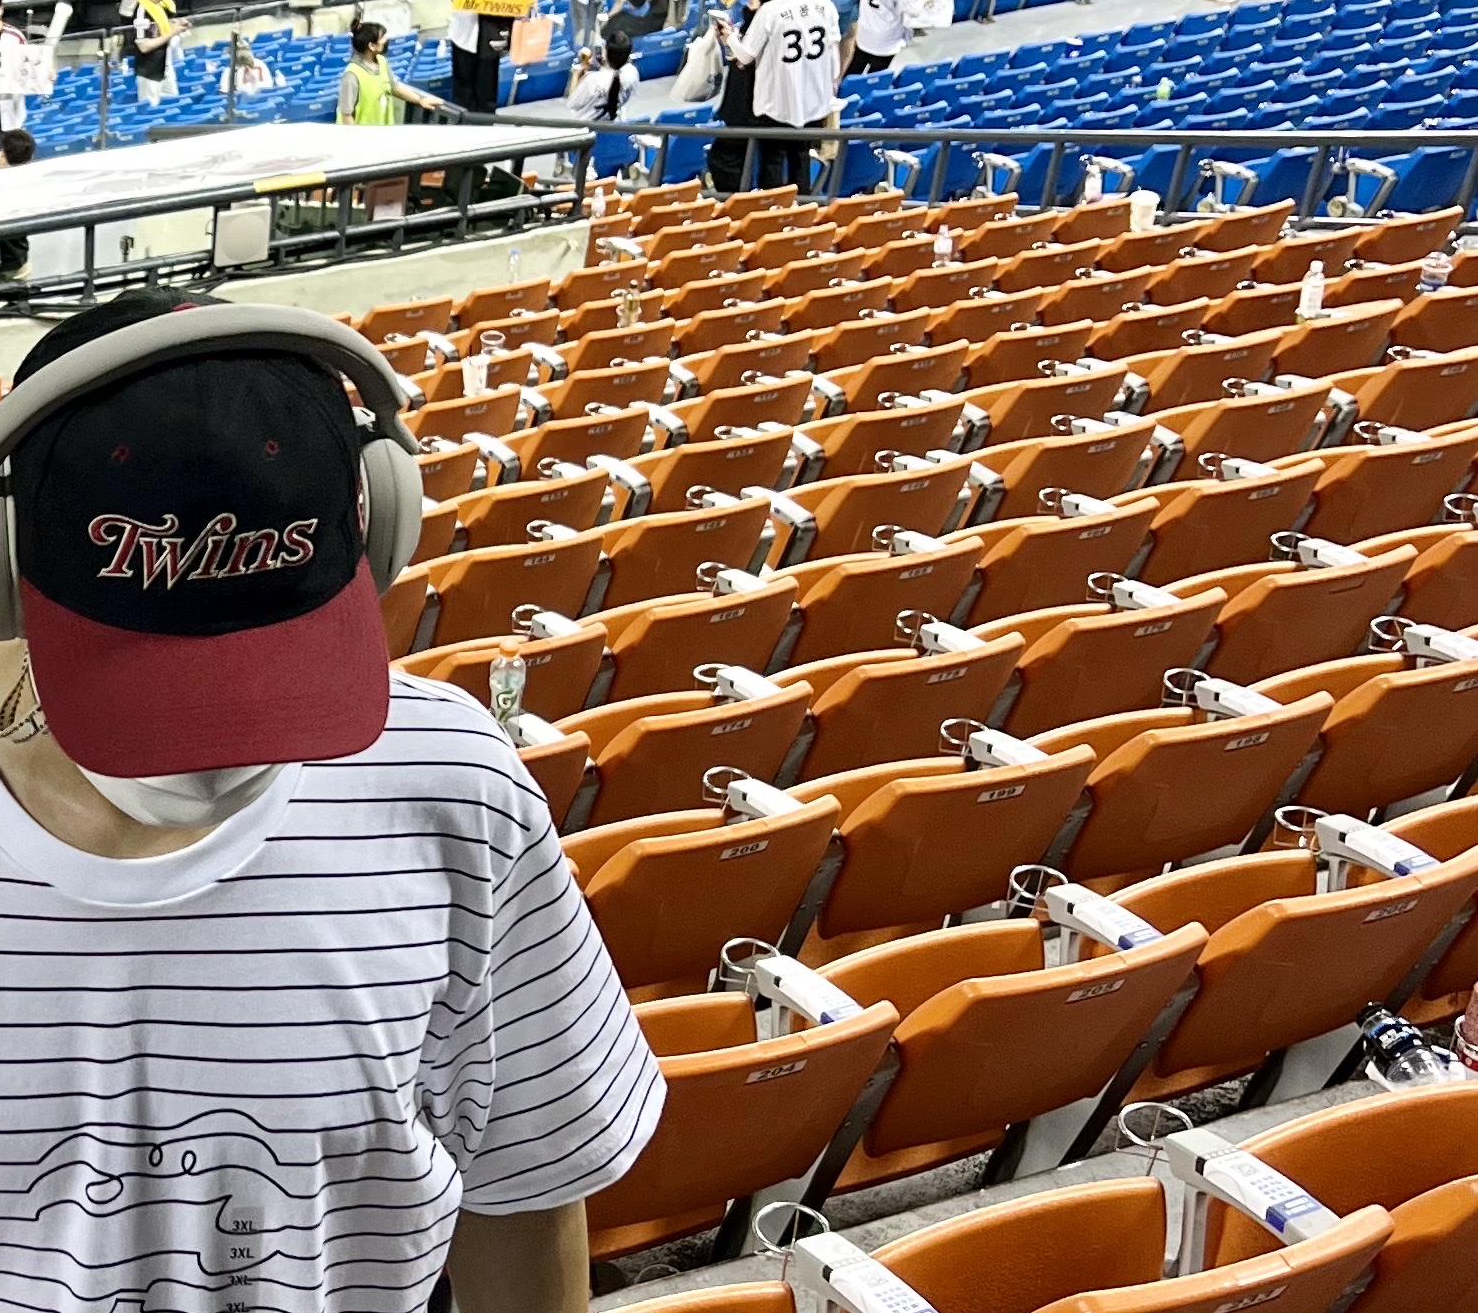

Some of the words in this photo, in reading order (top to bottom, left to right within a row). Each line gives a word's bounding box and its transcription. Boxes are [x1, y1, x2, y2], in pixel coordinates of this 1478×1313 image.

[483, 0, 523, 15] TWINS
[781, 25, 827, 64] 33
[88, 511, 319, 592] Twins
[988, 787, 1018, 801] 199
[729, 843, 762, 858] 200
[757, 1062, 796, 1081] 204
[232, 1220, 257, 1232] 3XL
[229, 1248, 255, 1259] 3XL
[226, 1275, 252, 1286] 3XL
[225, 1302, 250, 1313] 3XL
